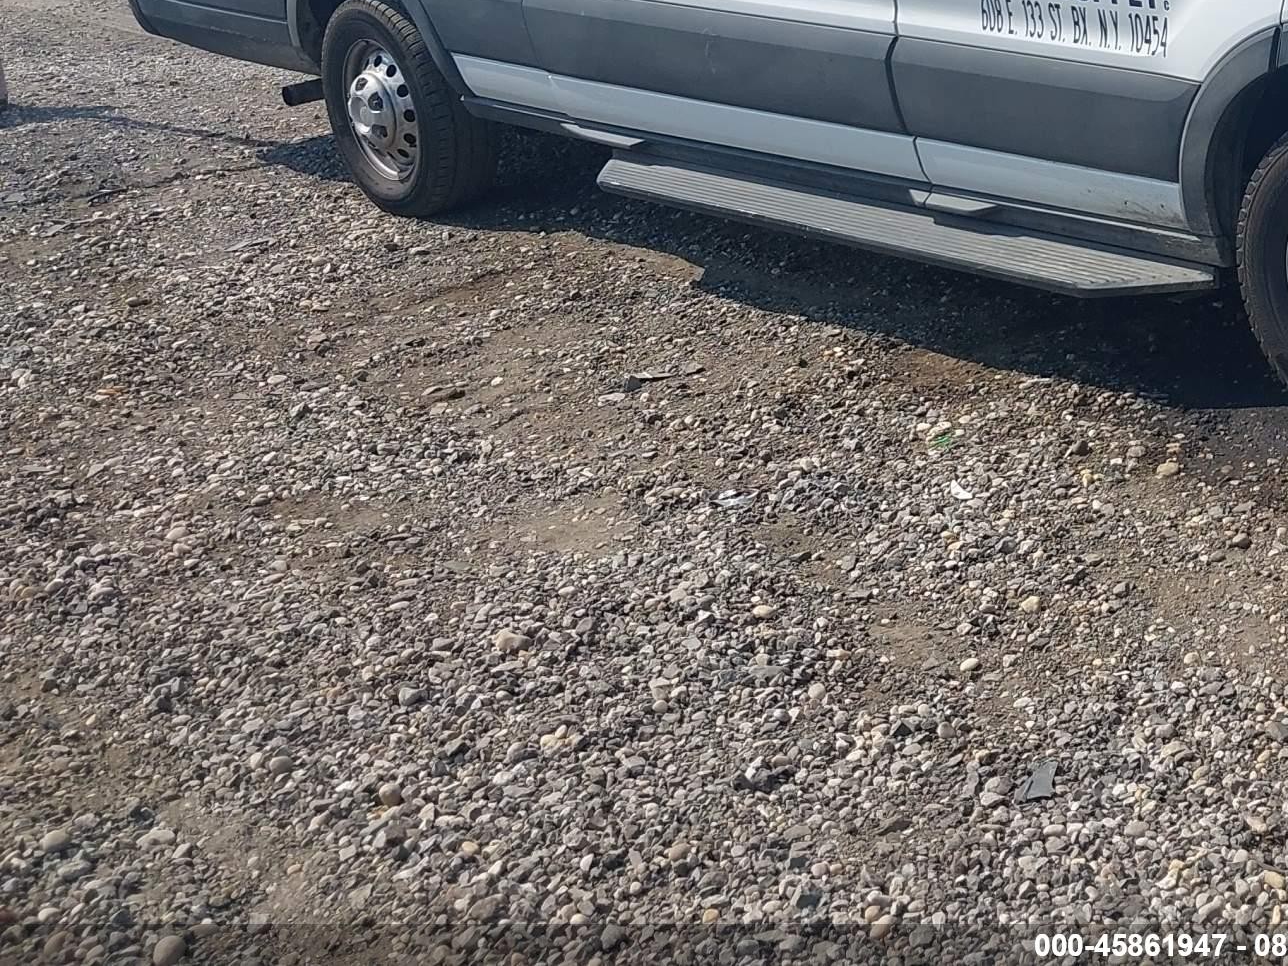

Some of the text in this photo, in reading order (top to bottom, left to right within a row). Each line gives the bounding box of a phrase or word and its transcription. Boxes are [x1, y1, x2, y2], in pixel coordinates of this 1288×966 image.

[1022, 0, 1044, 39] 133
[1048, 3, 1066, 42] ST.
[1072, 6, 1091, 46] BX.
[1098, 9, 1122, 51] N.Y.
[1128, 13, 1168, 58] 10454
